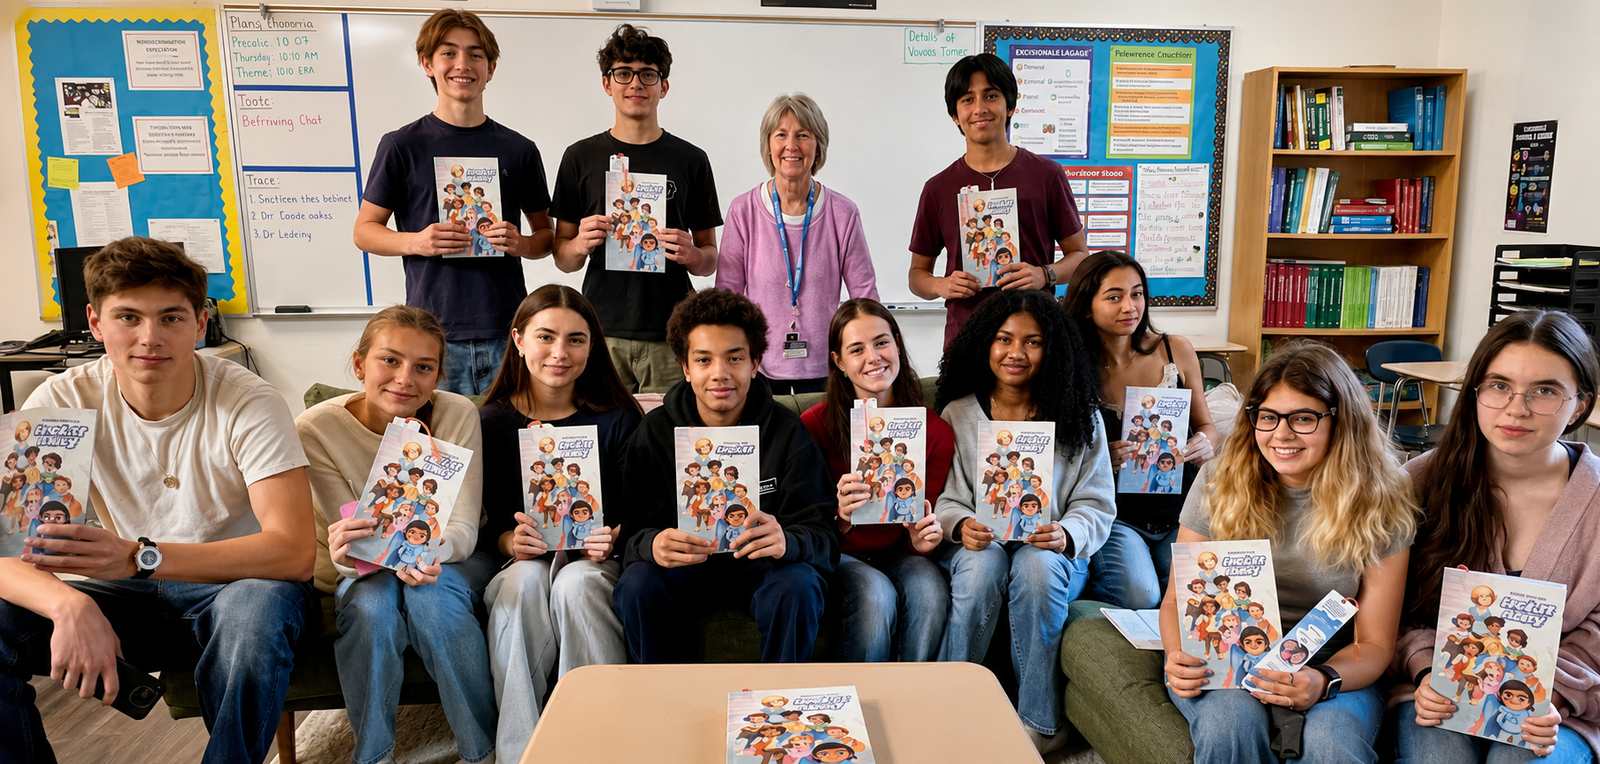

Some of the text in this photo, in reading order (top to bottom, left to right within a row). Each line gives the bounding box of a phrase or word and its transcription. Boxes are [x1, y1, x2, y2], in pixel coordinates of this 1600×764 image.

[946, 33, 955, 42] of
[279, 52, 300, 61] 10:10
[304, 52, 319, 60] AM
[300, 114, 322, 125] Chat
[246, 174, 280, 186] Trace:
[254, 229, 261, 238] 3.
[263, 230, 274, 239] Dr
